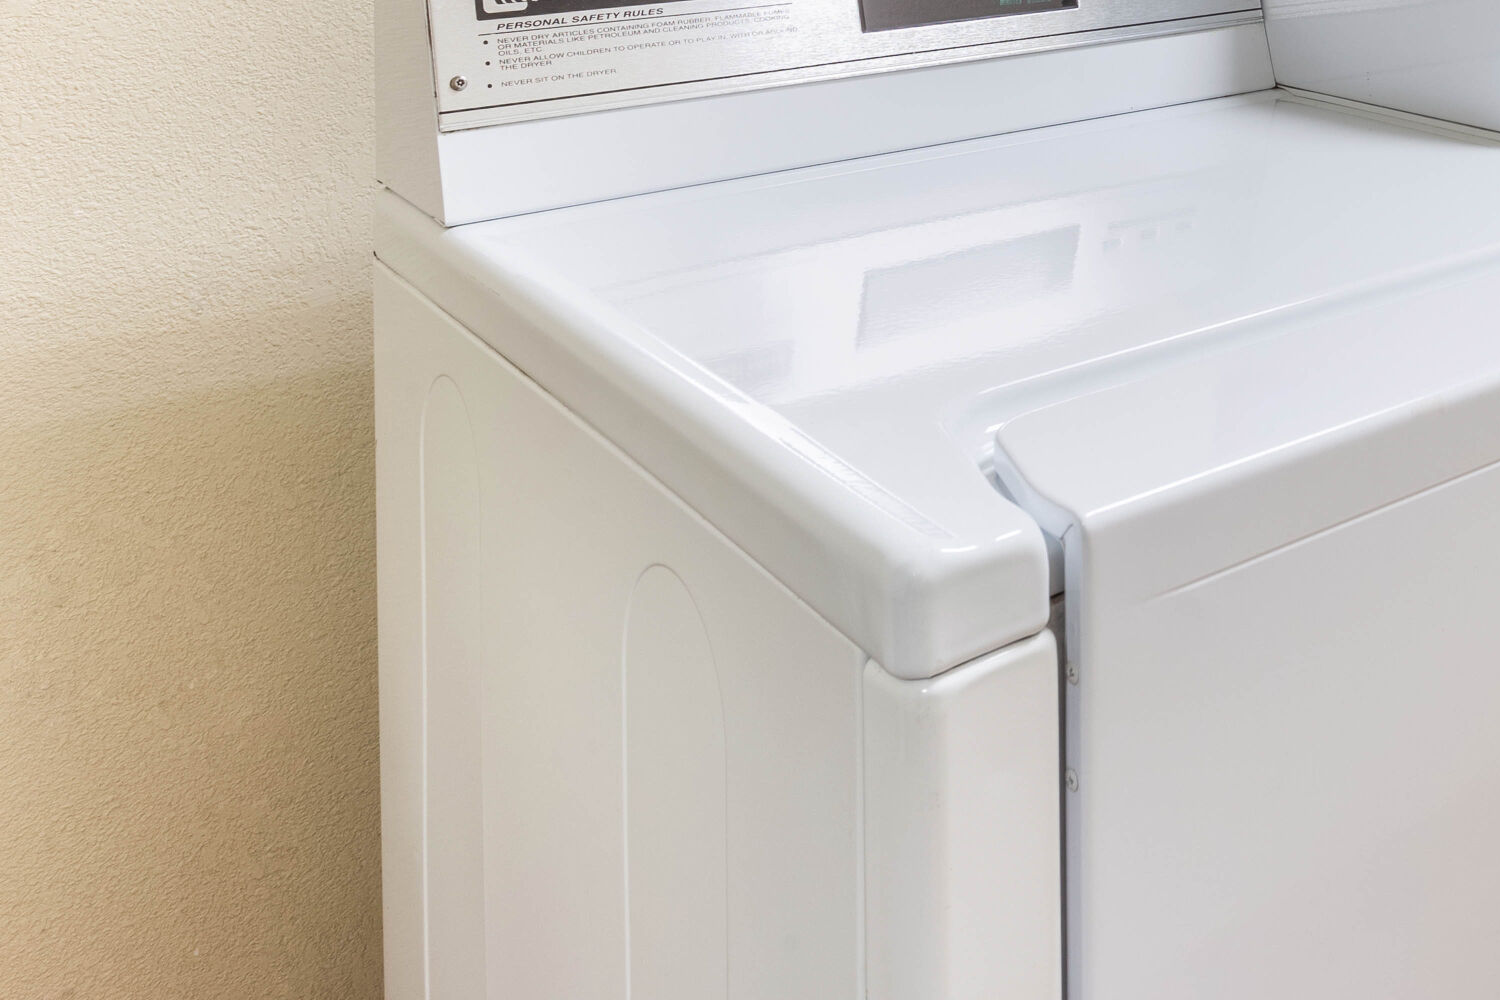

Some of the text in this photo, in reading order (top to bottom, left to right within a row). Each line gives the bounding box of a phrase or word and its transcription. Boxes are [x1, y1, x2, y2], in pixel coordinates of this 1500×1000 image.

[497, 8, 664, 30] PERSONAL SAFETY RULES
[501, 79, 533, 87] NEVER
[535, 76, 549, 84] SIT
[587, 69, 617, 77] DRYER
